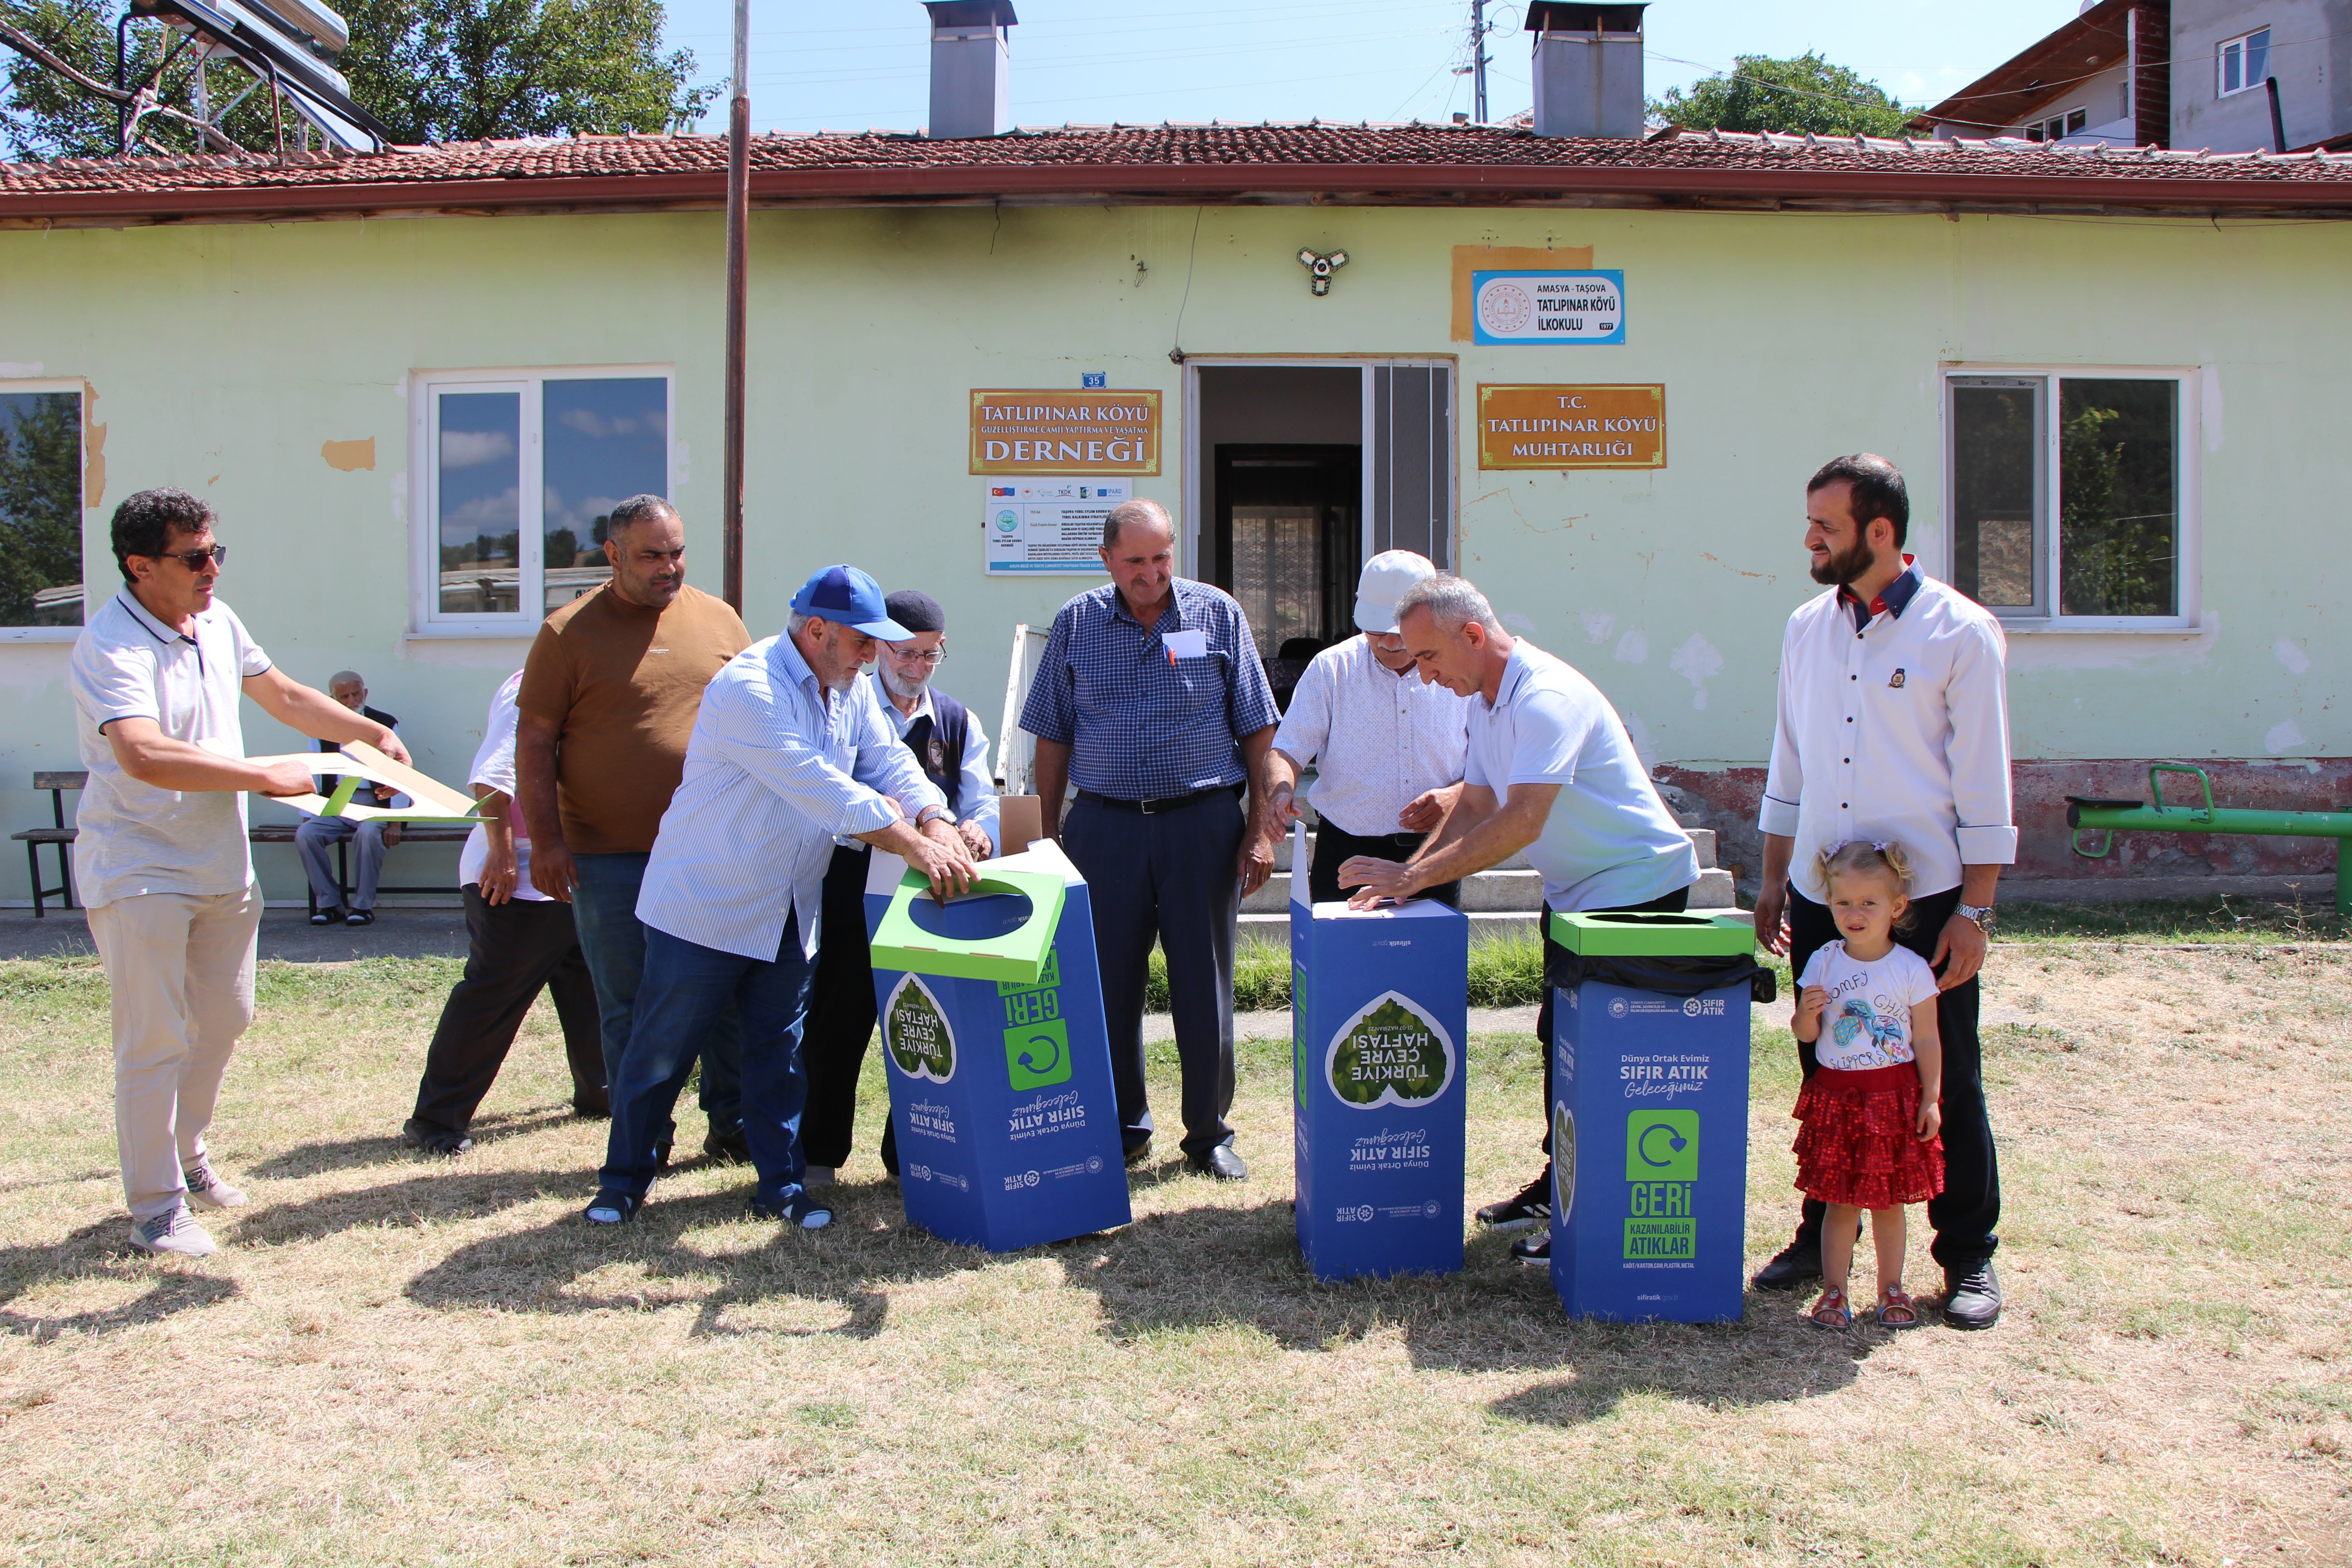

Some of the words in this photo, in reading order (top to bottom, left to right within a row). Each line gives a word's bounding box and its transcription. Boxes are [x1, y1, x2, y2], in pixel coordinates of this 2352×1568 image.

[1537, 284, 1570, 293] AMASYA
[1576, 284, 1606, 294] TAŞOVA
[1537, 299, 1588, 311] TATLIPINAR
[1591, 296, 1615, 311] KÖYÜ
[1538, 316, 1583, 330] İLKOKULU
[1089, 377, 1099, 385] 35
[1557, 396, 1587, 408] T.C.
[981, 406, 1092, 421] TATLIPINAR
[1096, 403, 1148, 421] KÖYÜ
[981, 425, 1039, 435] GÜZELLİŞTİRME
[1041, 425, 1063, 433] CAMİİ
[1066, 426, 1103, 434] YAPTIRMA
[1116, 426, 1148, 435] YAŞATMA
[1487, 418, 1599, 432] TATLIPINAR
[1604, 416, 1656, 432] KÖYÜ
[984, 435, 1146, 461] DERNEĞİ
[1512, 440, 1633, 456] MUHTARLIĞI
[1703, 1007, 1724, 1015] ATIK
[896, 1009, 938, 1028] HAFTASI
[902, 1024, 936, 1041] ÇEVRE
[1353, 1033, 1428, 1049] HAFTASI
[899, 1037, 943, 1059] TÜRKİYE
[1360, 1046, 1420, 1064] ÇEVRE
[1622, 1055, 1650, 1064] Dünya
[1352, 1064, 1429, 1083] TÜRKİYE
[1620, 1066, 1663, 1079] SIFIR
[1667, 1066, 1709, 1079] ATIK
[1625, 1080, 1703, 1101] Geleceğimiz
[1012, 1090, 1078, 1117] Geleceğimiz
[910, 1112, 930, 1127] ATIK
[1047, 1105, 1085, 1123] SIFIR
[932, 1117, 955, 1133] SIFIR
[1009, 1113, 1044, 1132] ATIK
[1061, 1120, 1086, 1129] Dünya
[911, 1126, 926, 1135] Evimiz
[927, 1130, 940, 1139] Ortak
[1010, 1130, 1035, 1141] Evimiz
[1037, 1126, 1059, 1136] Ortak
[941, 1134, 956, 1143] Dünya
[1355, 1128, 1426, 1147] Geleceğimiz
[1350, 1147, 1387, 1161] ATIK
[1391, 1146, 1430, 1159] SIFIR
[910, 1163, 921, 1171] ATIK
[1350, 1163, 1375, 1171] Evimiz
[1403, 1160, 1429, 1168] Dünya
[911, 1170, 922, 1178] SIFIR
[1004, 1174, 1022, 1184] ATIK
[1005, 1181, 1024, 1191] SIFIR
[1337, 1207, 1356, 1215] ATIK
[1630, 1222, 1690, 1234] KAZANILABİLİR
[1629, 1237, 1689, 1254] ATIKLAR
